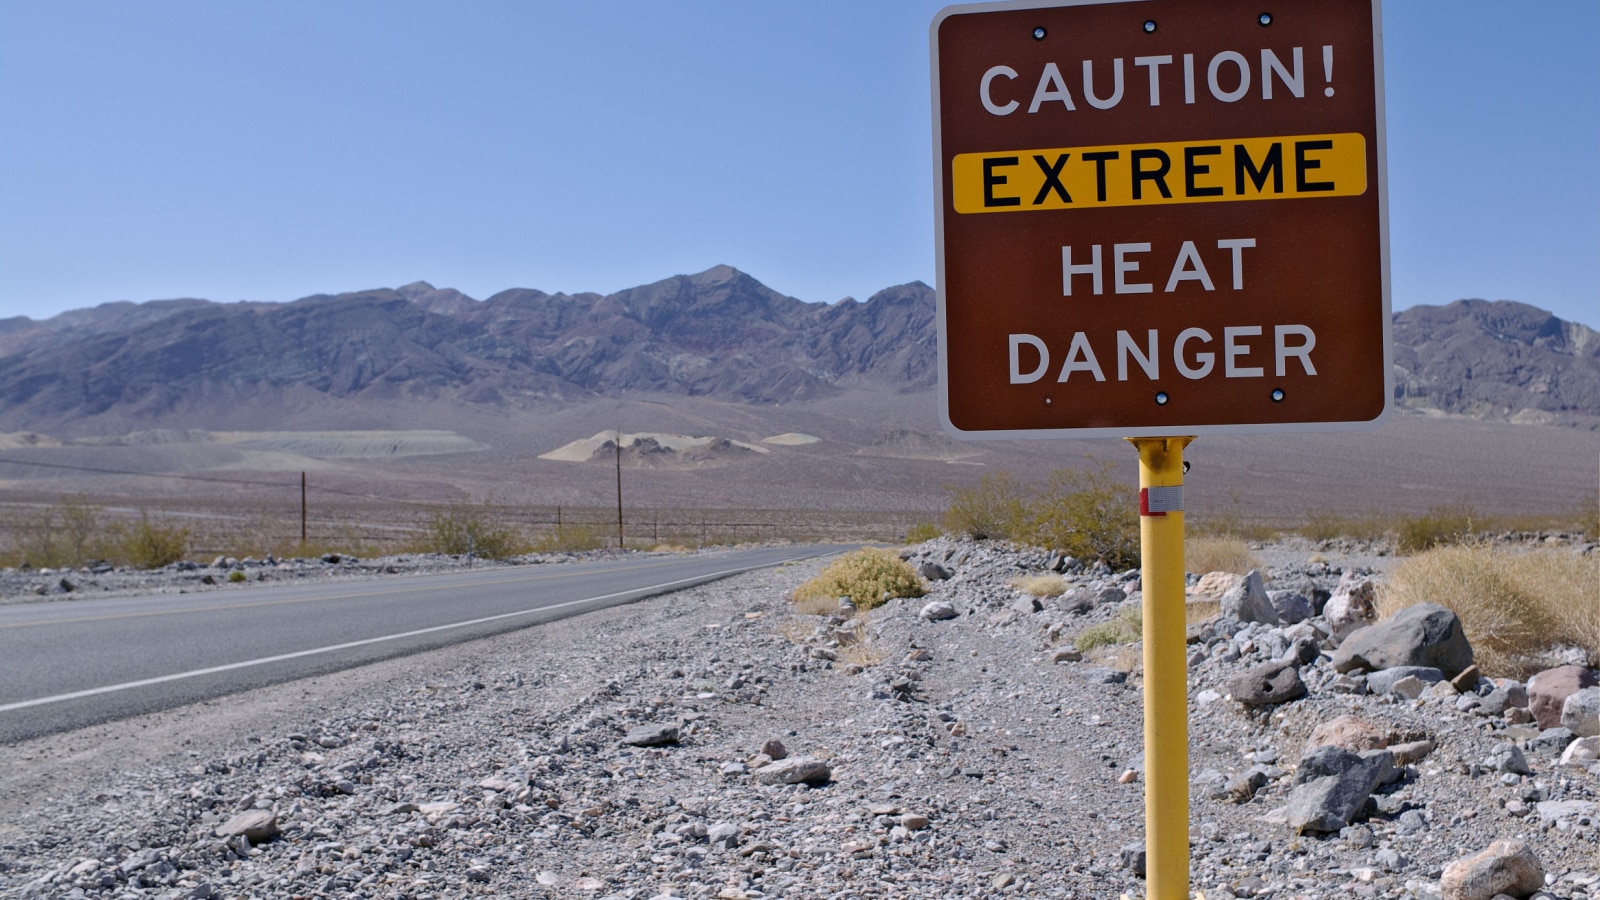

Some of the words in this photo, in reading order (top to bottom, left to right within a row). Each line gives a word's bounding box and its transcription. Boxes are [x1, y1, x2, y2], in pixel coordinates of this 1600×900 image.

[979, 45, 1335, 116] CAUTION!
[983, 139, 1336, 207] EXTREME
[1061, 238, 1256, 297] HEAT
[1008, 324, 1318, 385] DANGER
